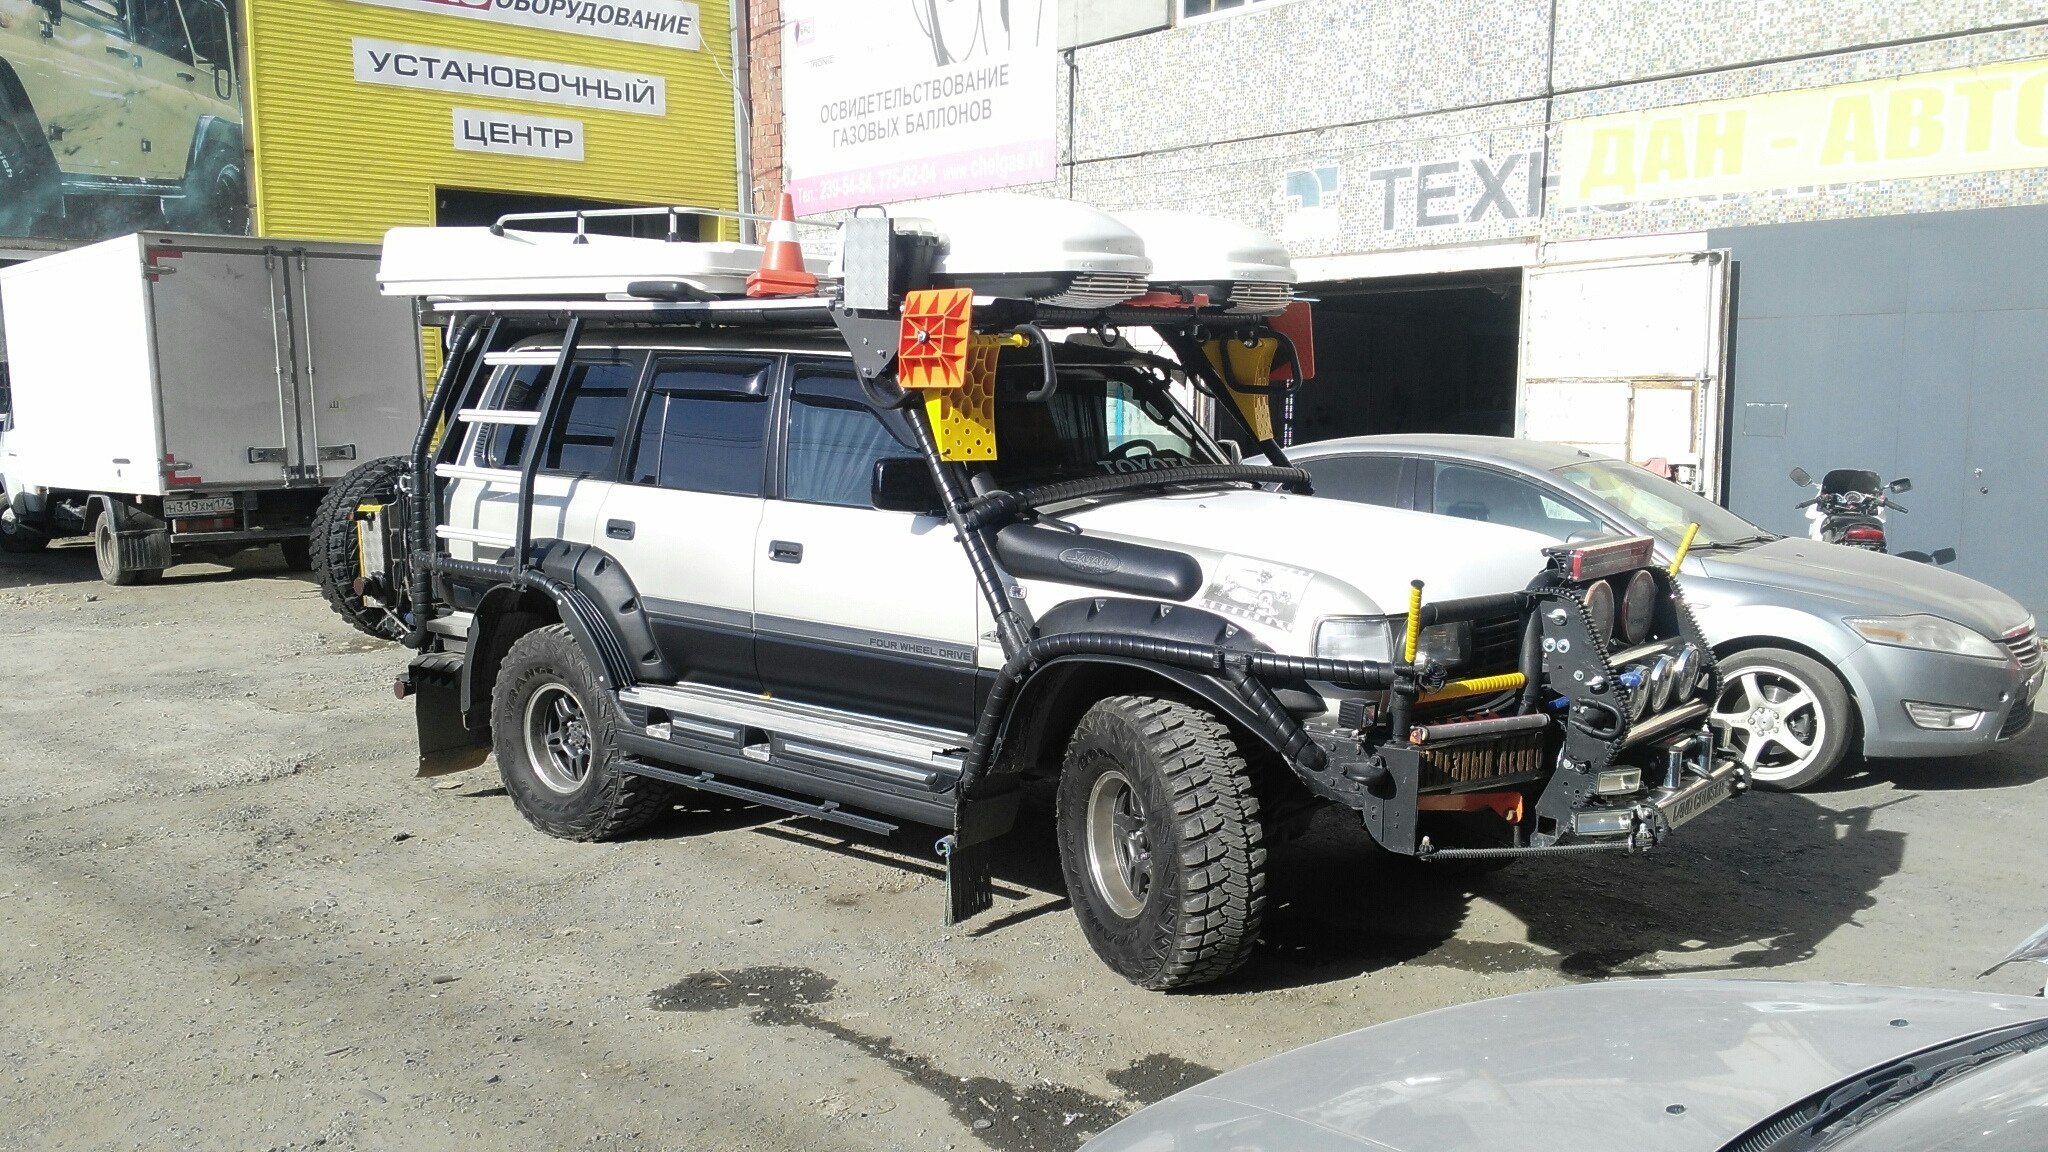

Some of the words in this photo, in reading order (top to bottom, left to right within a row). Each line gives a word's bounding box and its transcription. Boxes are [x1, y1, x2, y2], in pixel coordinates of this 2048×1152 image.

[366, 48, 656, 107] УСТАНОВОЧНЫЙ
[820, 63, 1010, 125] ОСВИДЕТЕЛЬСТВОВАНИЕ
[463, 117, 575, 150] ЦЕНТР
[832, 118, 902, 149] ГАЗОВЫХ
[906, 98, 993, 135] БАЛЛОНОВ
[1579, 110, 1747, 199] ДАН
[869, 637, 898, 650] FOUR
[900, 642, 938, 656] WHEEL
[939, 648, 972, 661] DRIVE
